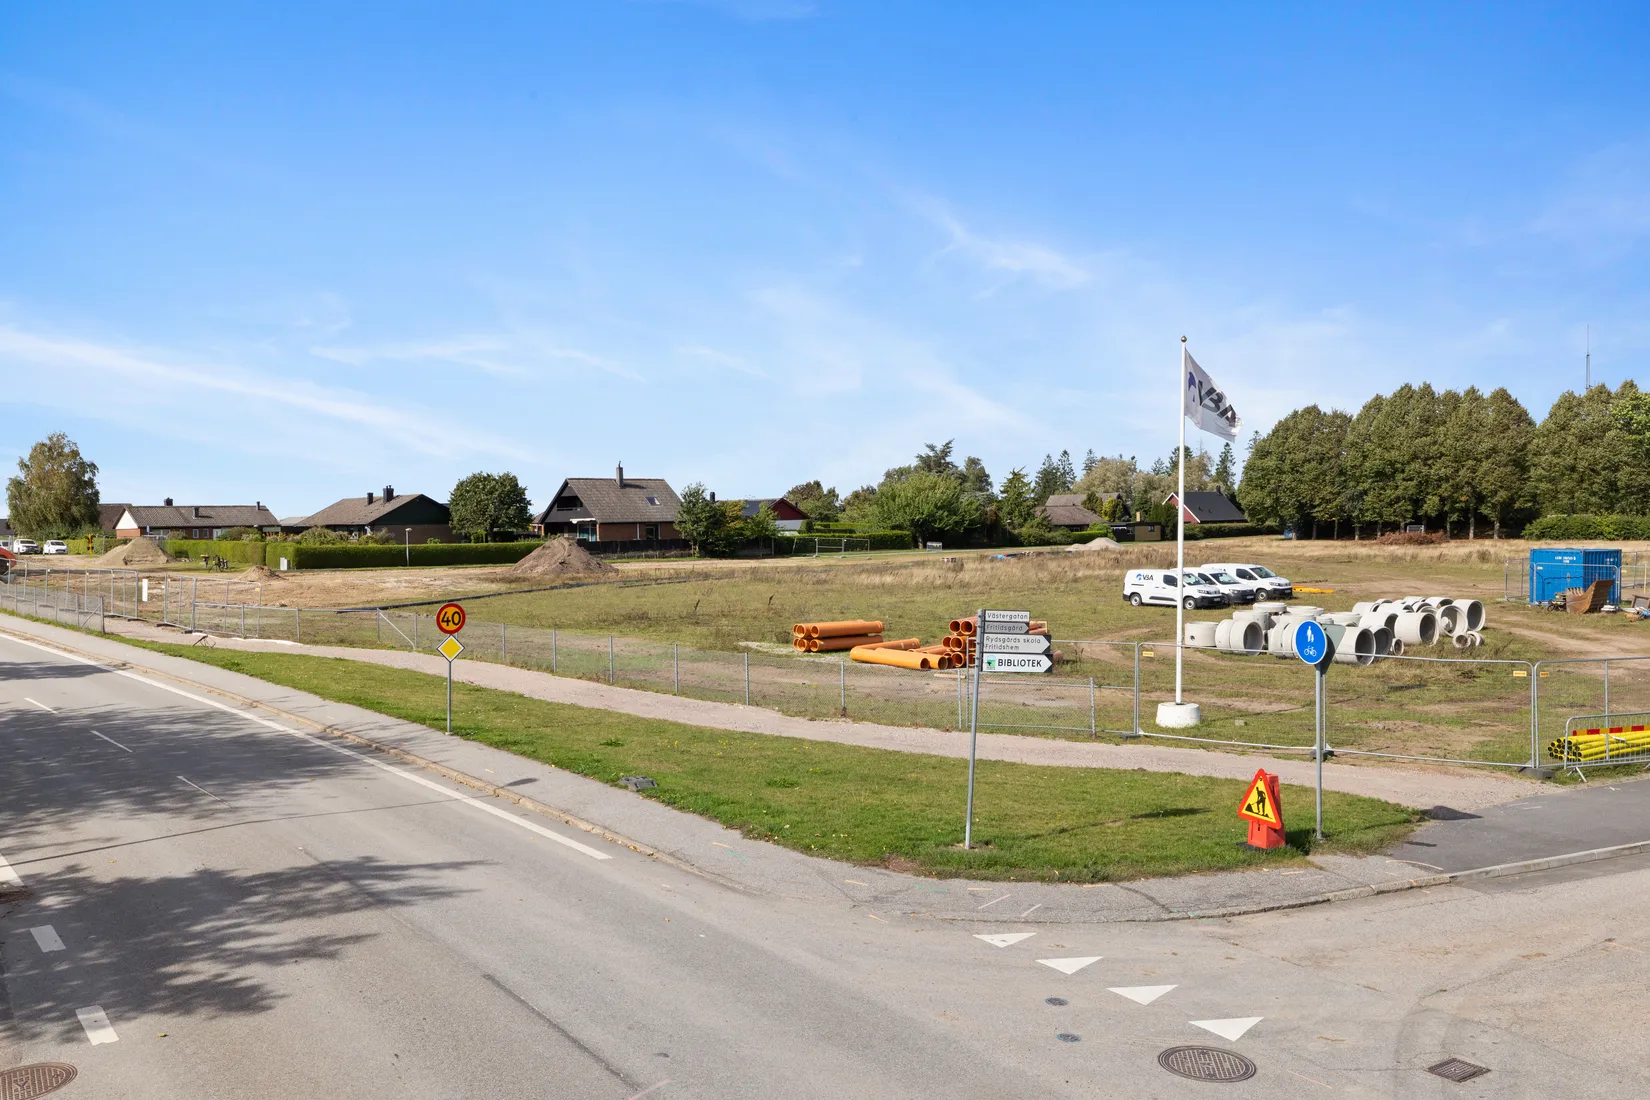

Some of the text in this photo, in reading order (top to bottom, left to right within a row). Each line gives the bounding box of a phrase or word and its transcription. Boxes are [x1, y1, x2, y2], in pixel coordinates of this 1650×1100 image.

[441, 611, 462, 627] 40
[987, 612, 1028, 620] Västergatan
[986, 623, 1023, 632] Fritidsgård
[985, 636, 1020, 644] Rydsgårds
[998, 658, 1042, 668] BIBLIOTEK
